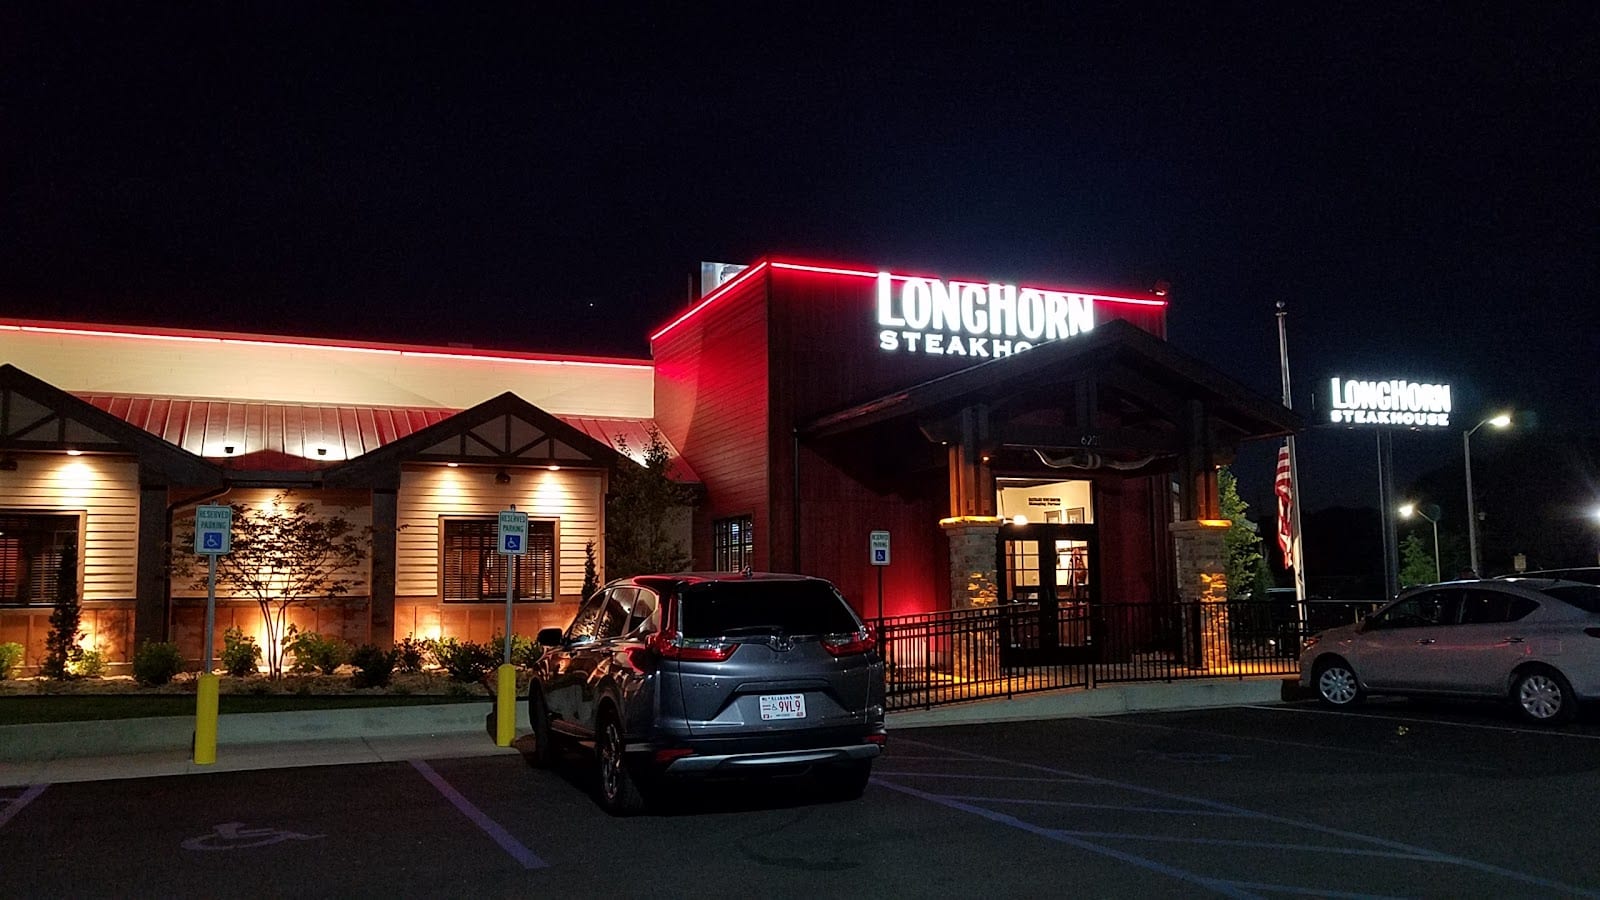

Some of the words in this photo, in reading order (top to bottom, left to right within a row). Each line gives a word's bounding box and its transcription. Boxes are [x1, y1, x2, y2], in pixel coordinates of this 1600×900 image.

[878, 272, 1095, 339] LONGHORN
[879, 330, 1043, 358] STEAKHO
[1331, 377, 1451, 412] LONGHORN
[1330, 410, 1449, 426] STEAKHOUSE
[199, 510, 229, 519] RESERVED
[200, 521, 227, 529] PARKING
[778, 700, 801, 712] 9VL9
